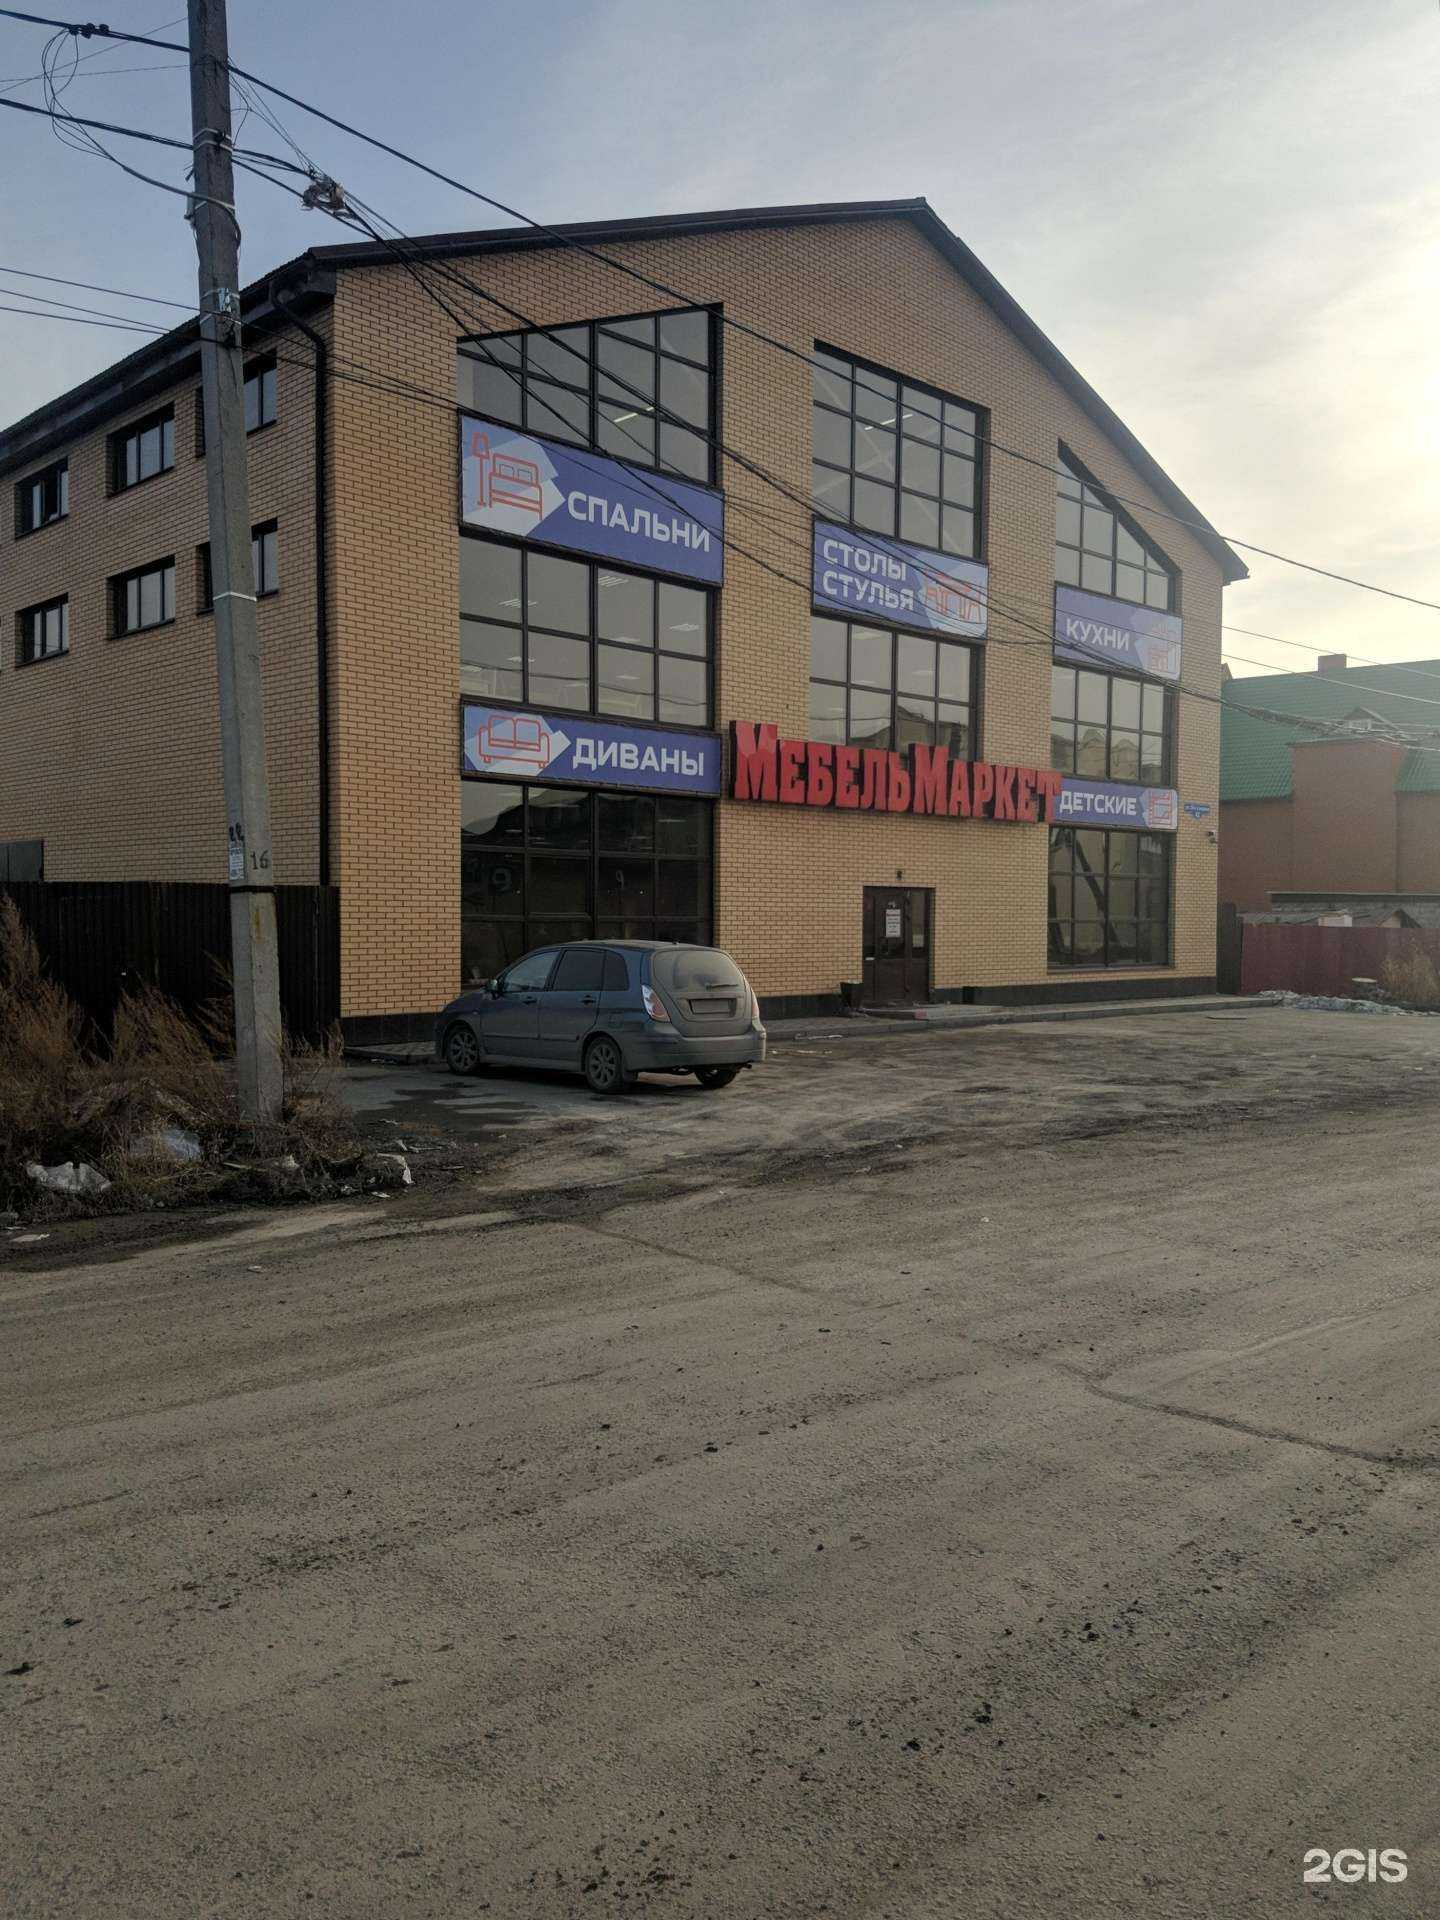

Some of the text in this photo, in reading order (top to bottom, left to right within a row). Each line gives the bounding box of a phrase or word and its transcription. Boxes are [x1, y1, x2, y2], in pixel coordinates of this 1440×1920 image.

[567, 491, 710, 552] СПАЛЬНИ
[823, 539, 907, 581] СТОЛЫ
[822, 570, 914, 611] СТУЛЬЯ
[1066, 618, 1130, 651] КУХНИ
[572, 738, 704, 777] ДИВАНЫ
[1060, 790, 1137, 816] ДЕТСКИЕ
[250, 850, 269, 870] 16
